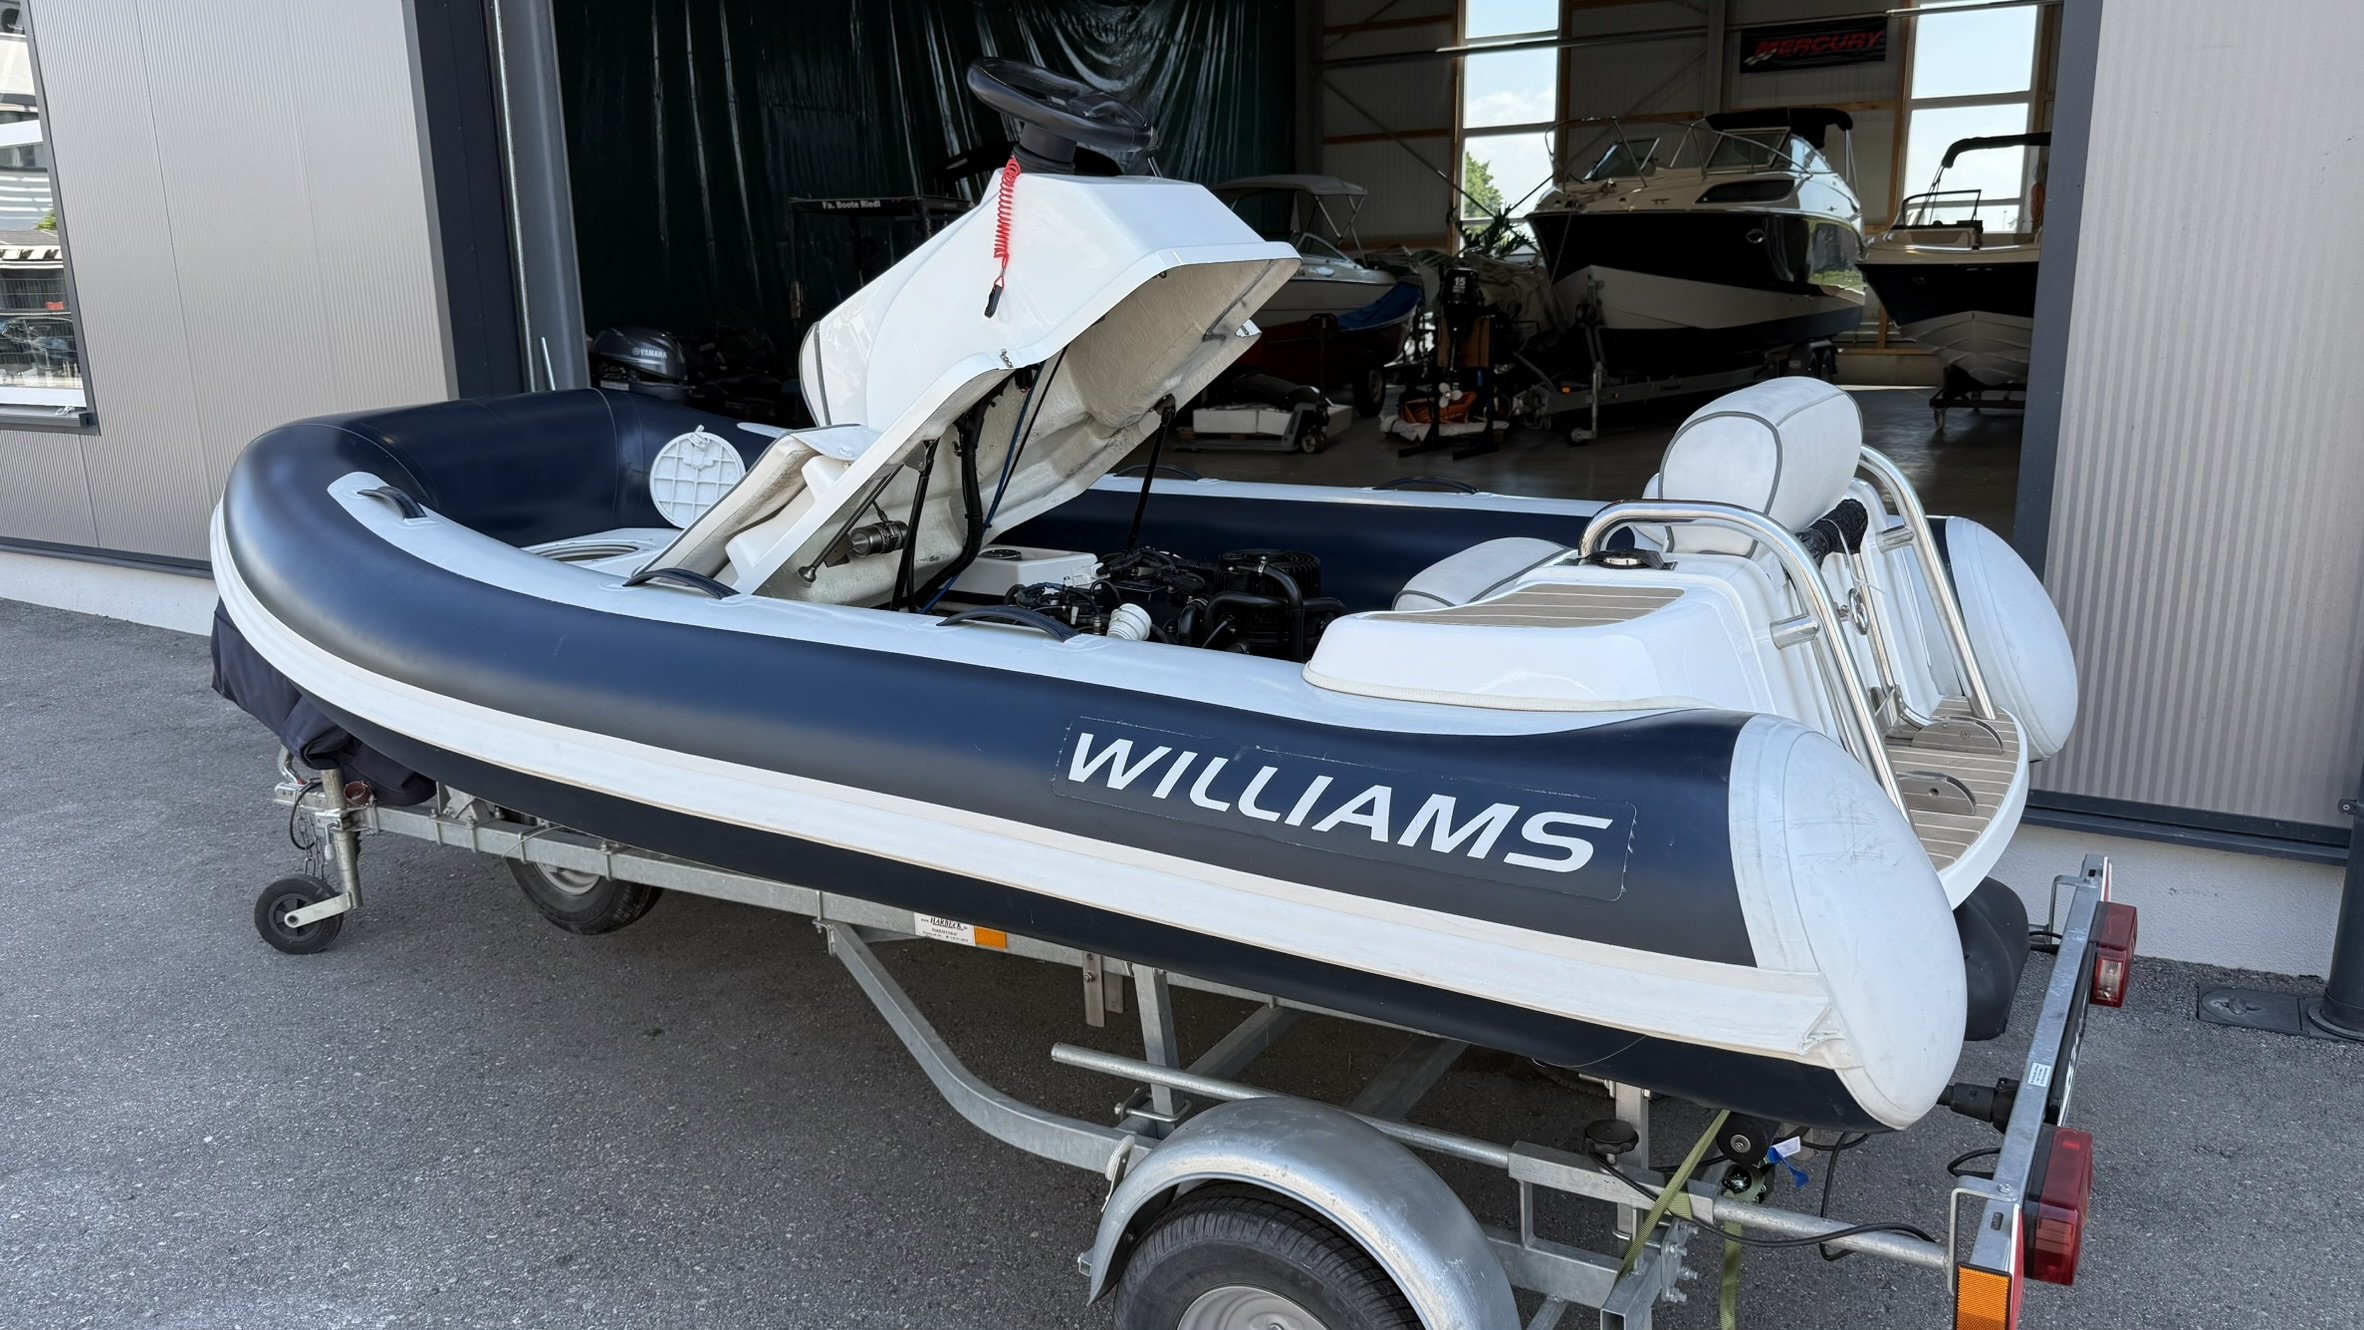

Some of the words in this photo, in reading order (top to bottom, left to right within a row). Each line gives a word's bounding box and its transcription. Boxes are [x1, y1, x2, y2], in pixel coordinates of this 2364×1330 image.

[1754, 30, 1884, 58] MERCURY
[860, 200, 881, 208] Riedl
[1454, 276, 1466, 286] 15
[640, 348, 667, 359] YAMAHA
[1067, 732, 1613, 873] WILLIAMS
